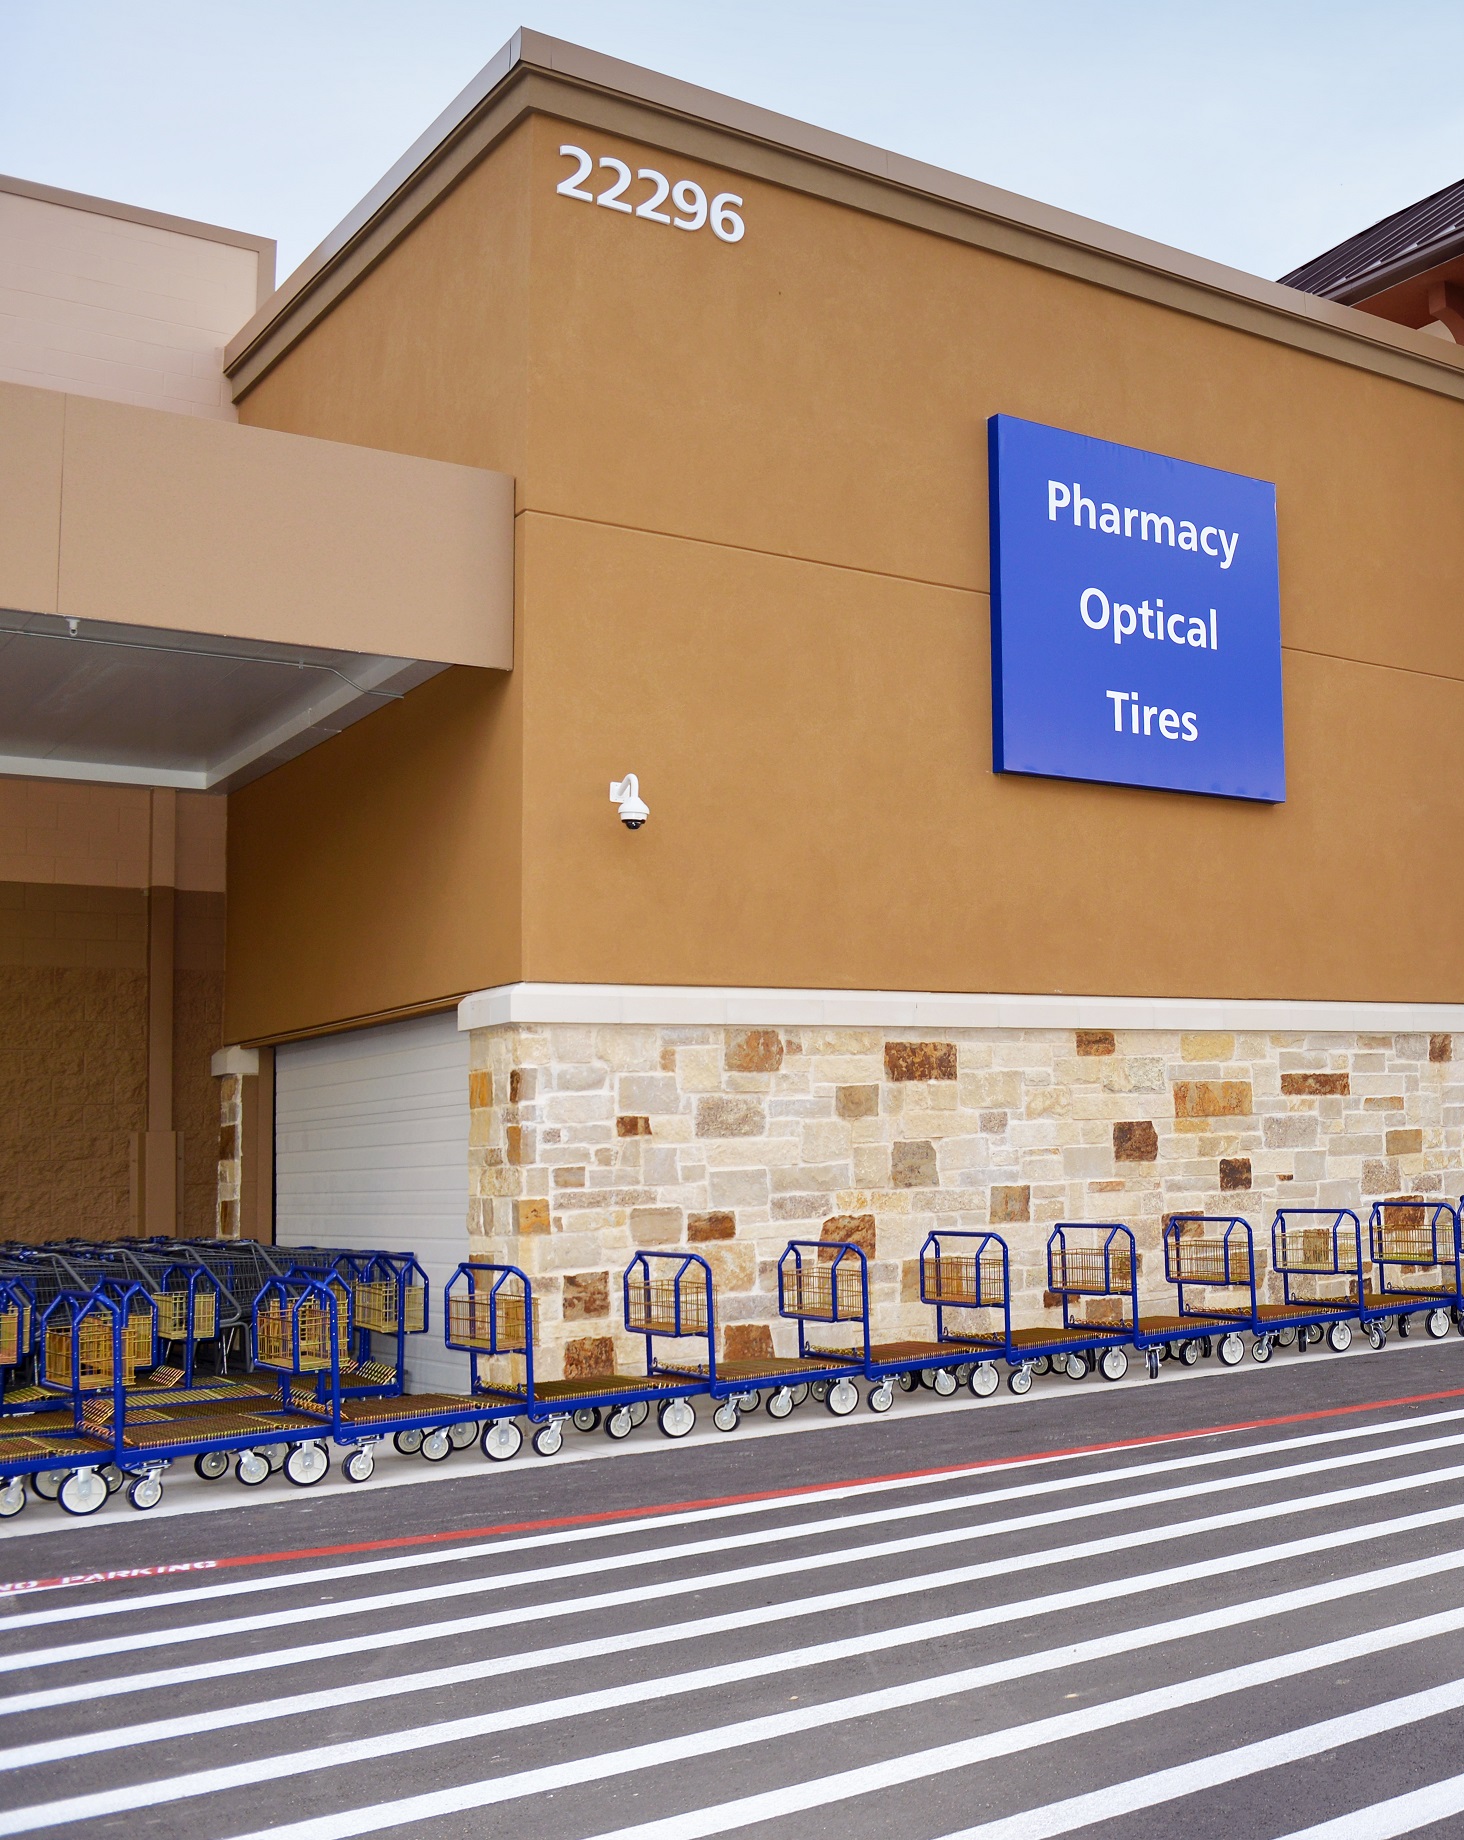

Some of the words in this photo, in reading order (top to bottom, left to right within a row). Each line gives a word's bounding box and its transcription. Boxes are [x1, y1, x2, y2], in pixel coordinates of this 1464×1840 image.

[557, 144, 745, 243] 22296
[1048, 480, 1239, 569] Pharmacy
[1080, 587, 1218, 650] Optical
[1106, 690, 1199, 741] Tires
[61, 1561, 217, 1584] PARKING
